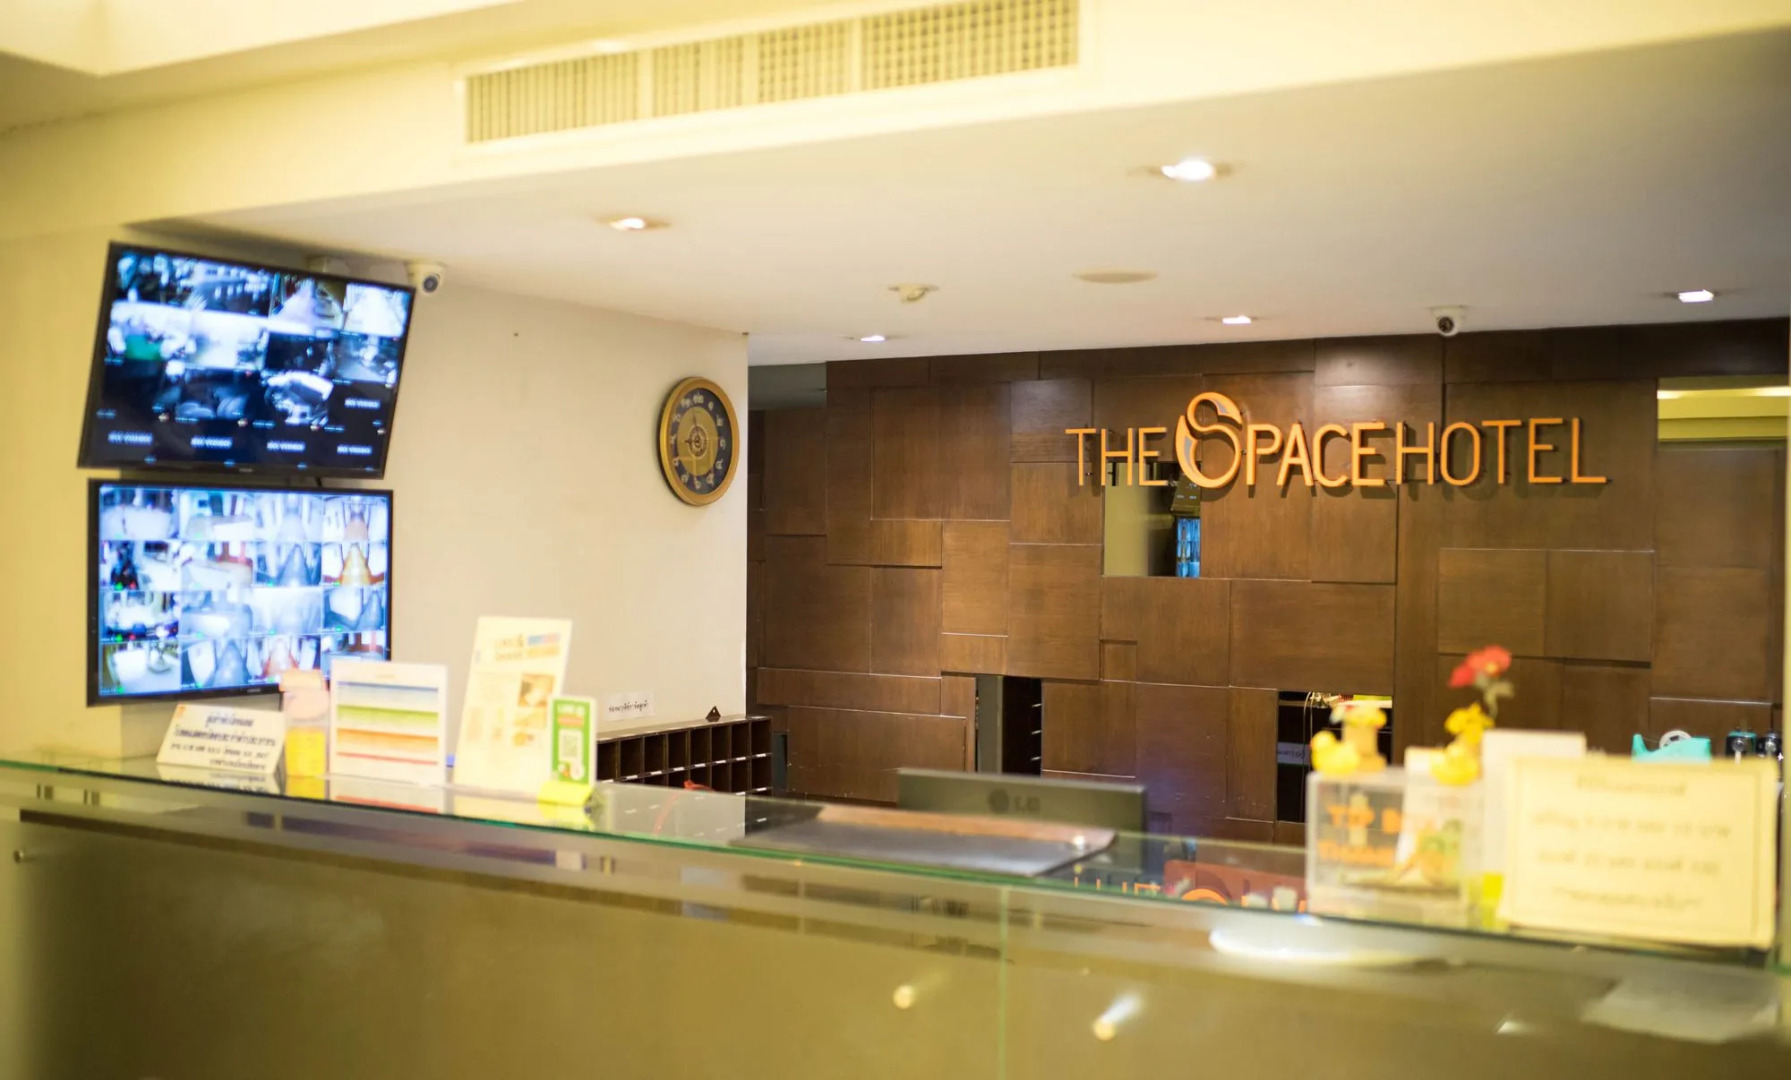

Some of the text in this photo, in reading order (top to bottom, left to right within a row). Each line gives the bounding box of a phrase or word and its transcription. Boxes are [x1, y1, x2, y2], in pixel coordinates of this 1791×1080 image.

[1065, 391, 1608, 489] THE SPACE HOTEL
